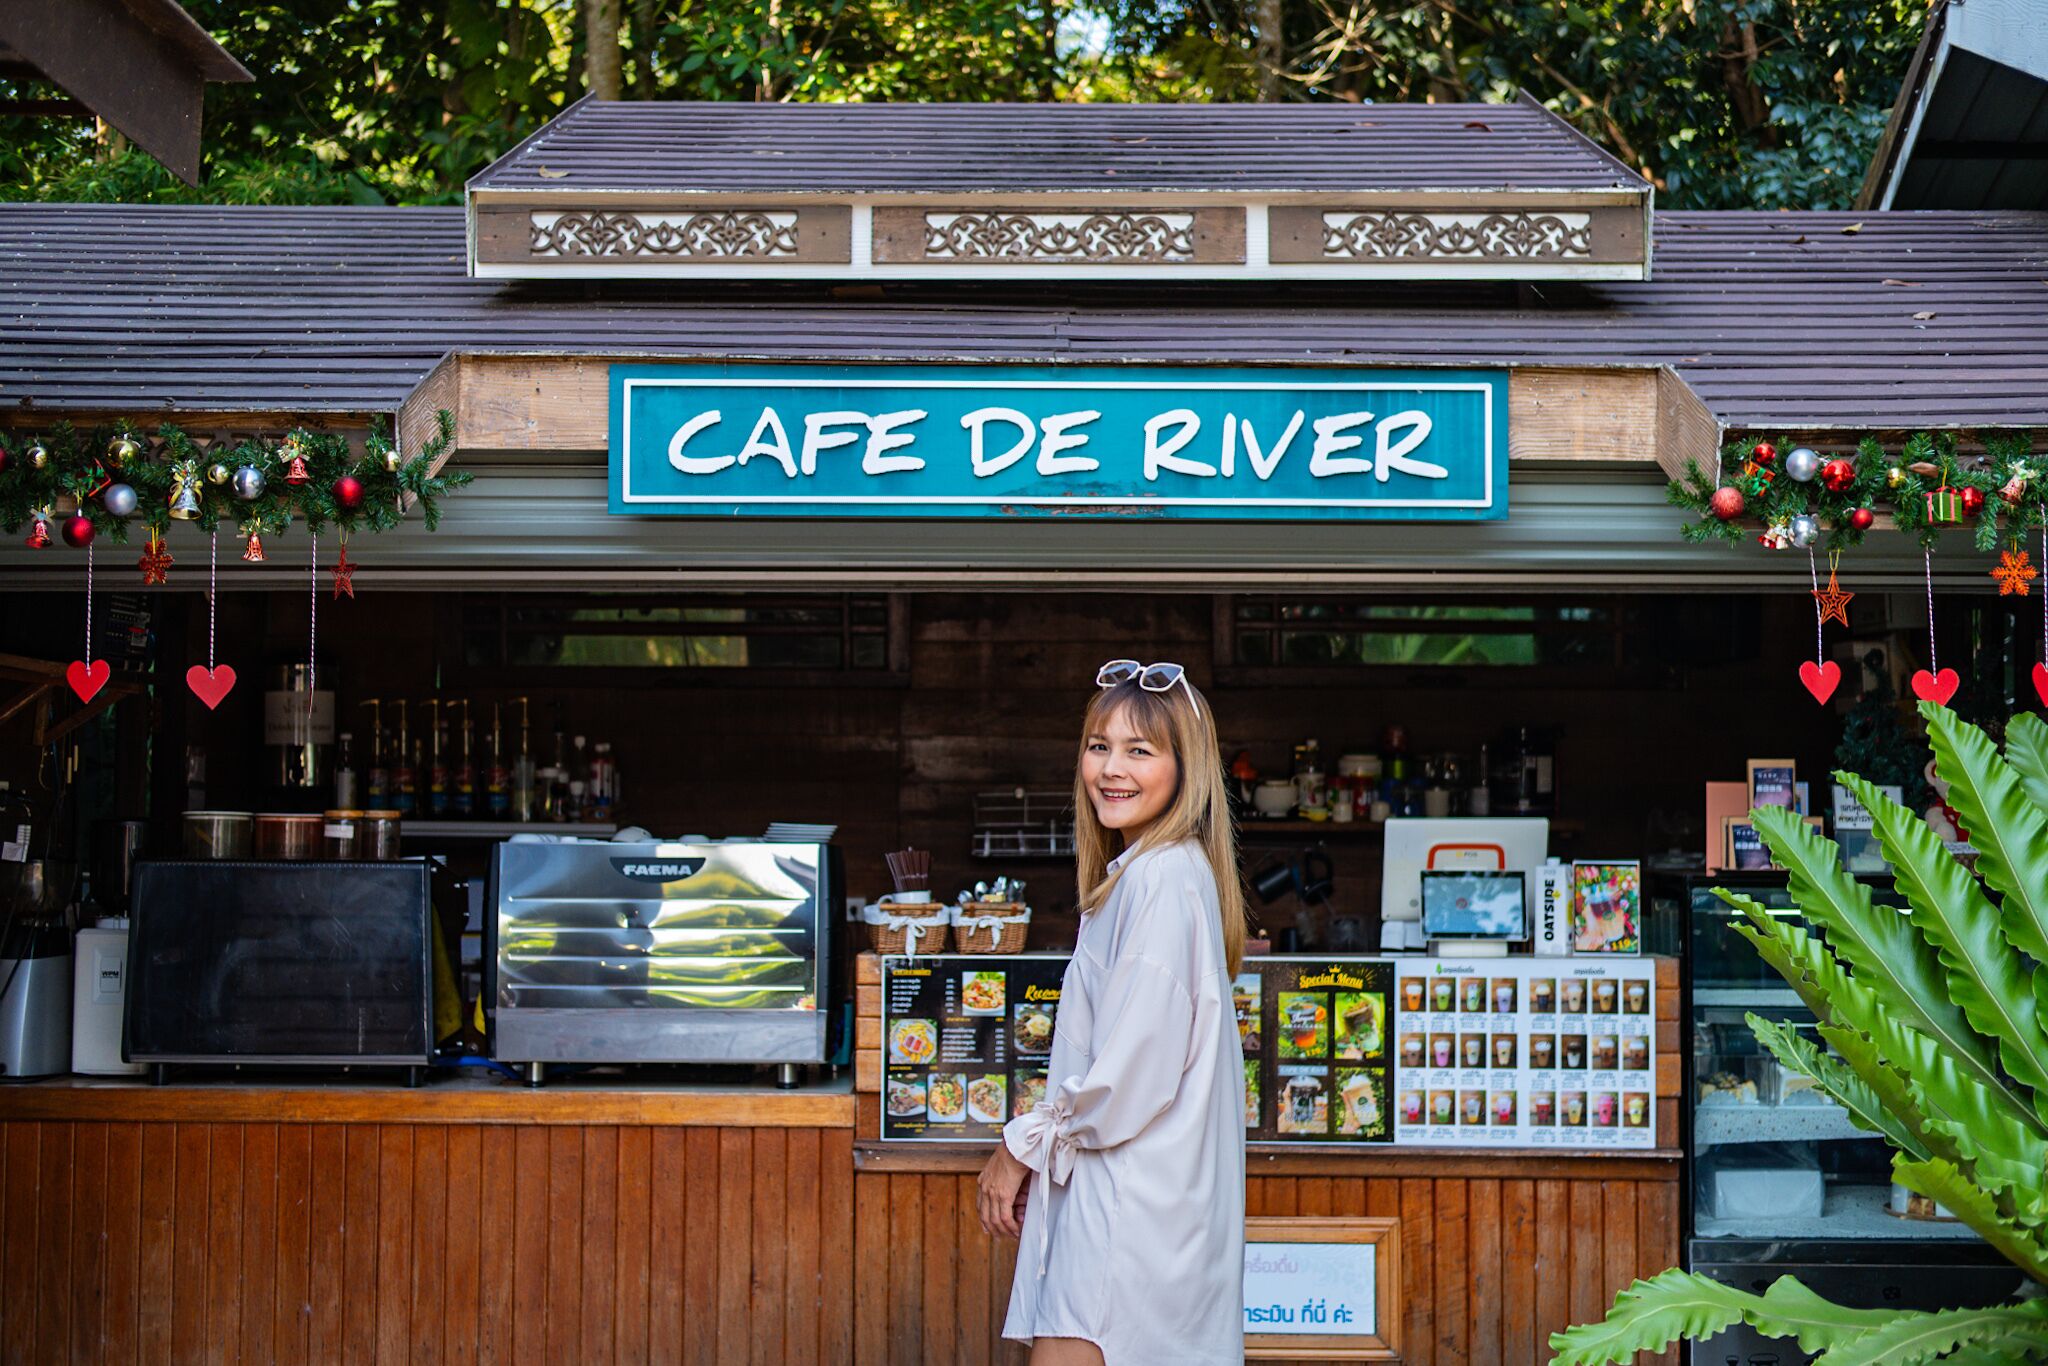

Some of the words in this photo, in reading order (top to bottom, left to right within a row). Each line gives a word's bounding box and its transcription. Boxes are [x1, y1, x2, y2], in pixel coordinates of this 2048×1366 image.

[668, 407, 928, 477] CAFE
[961, 407, 1101, 476] DE
[1144, 408, 1449, 482] RIVER
[623, 864, 692, 876] FAEMA
[1544, 879, 1555, 941] OATSIDE
[1299, 973, 1334, 988] Special
[1336, 973, 1363, 988] Menu
[1333, 1303, 1353, 1323] ค่ะ
